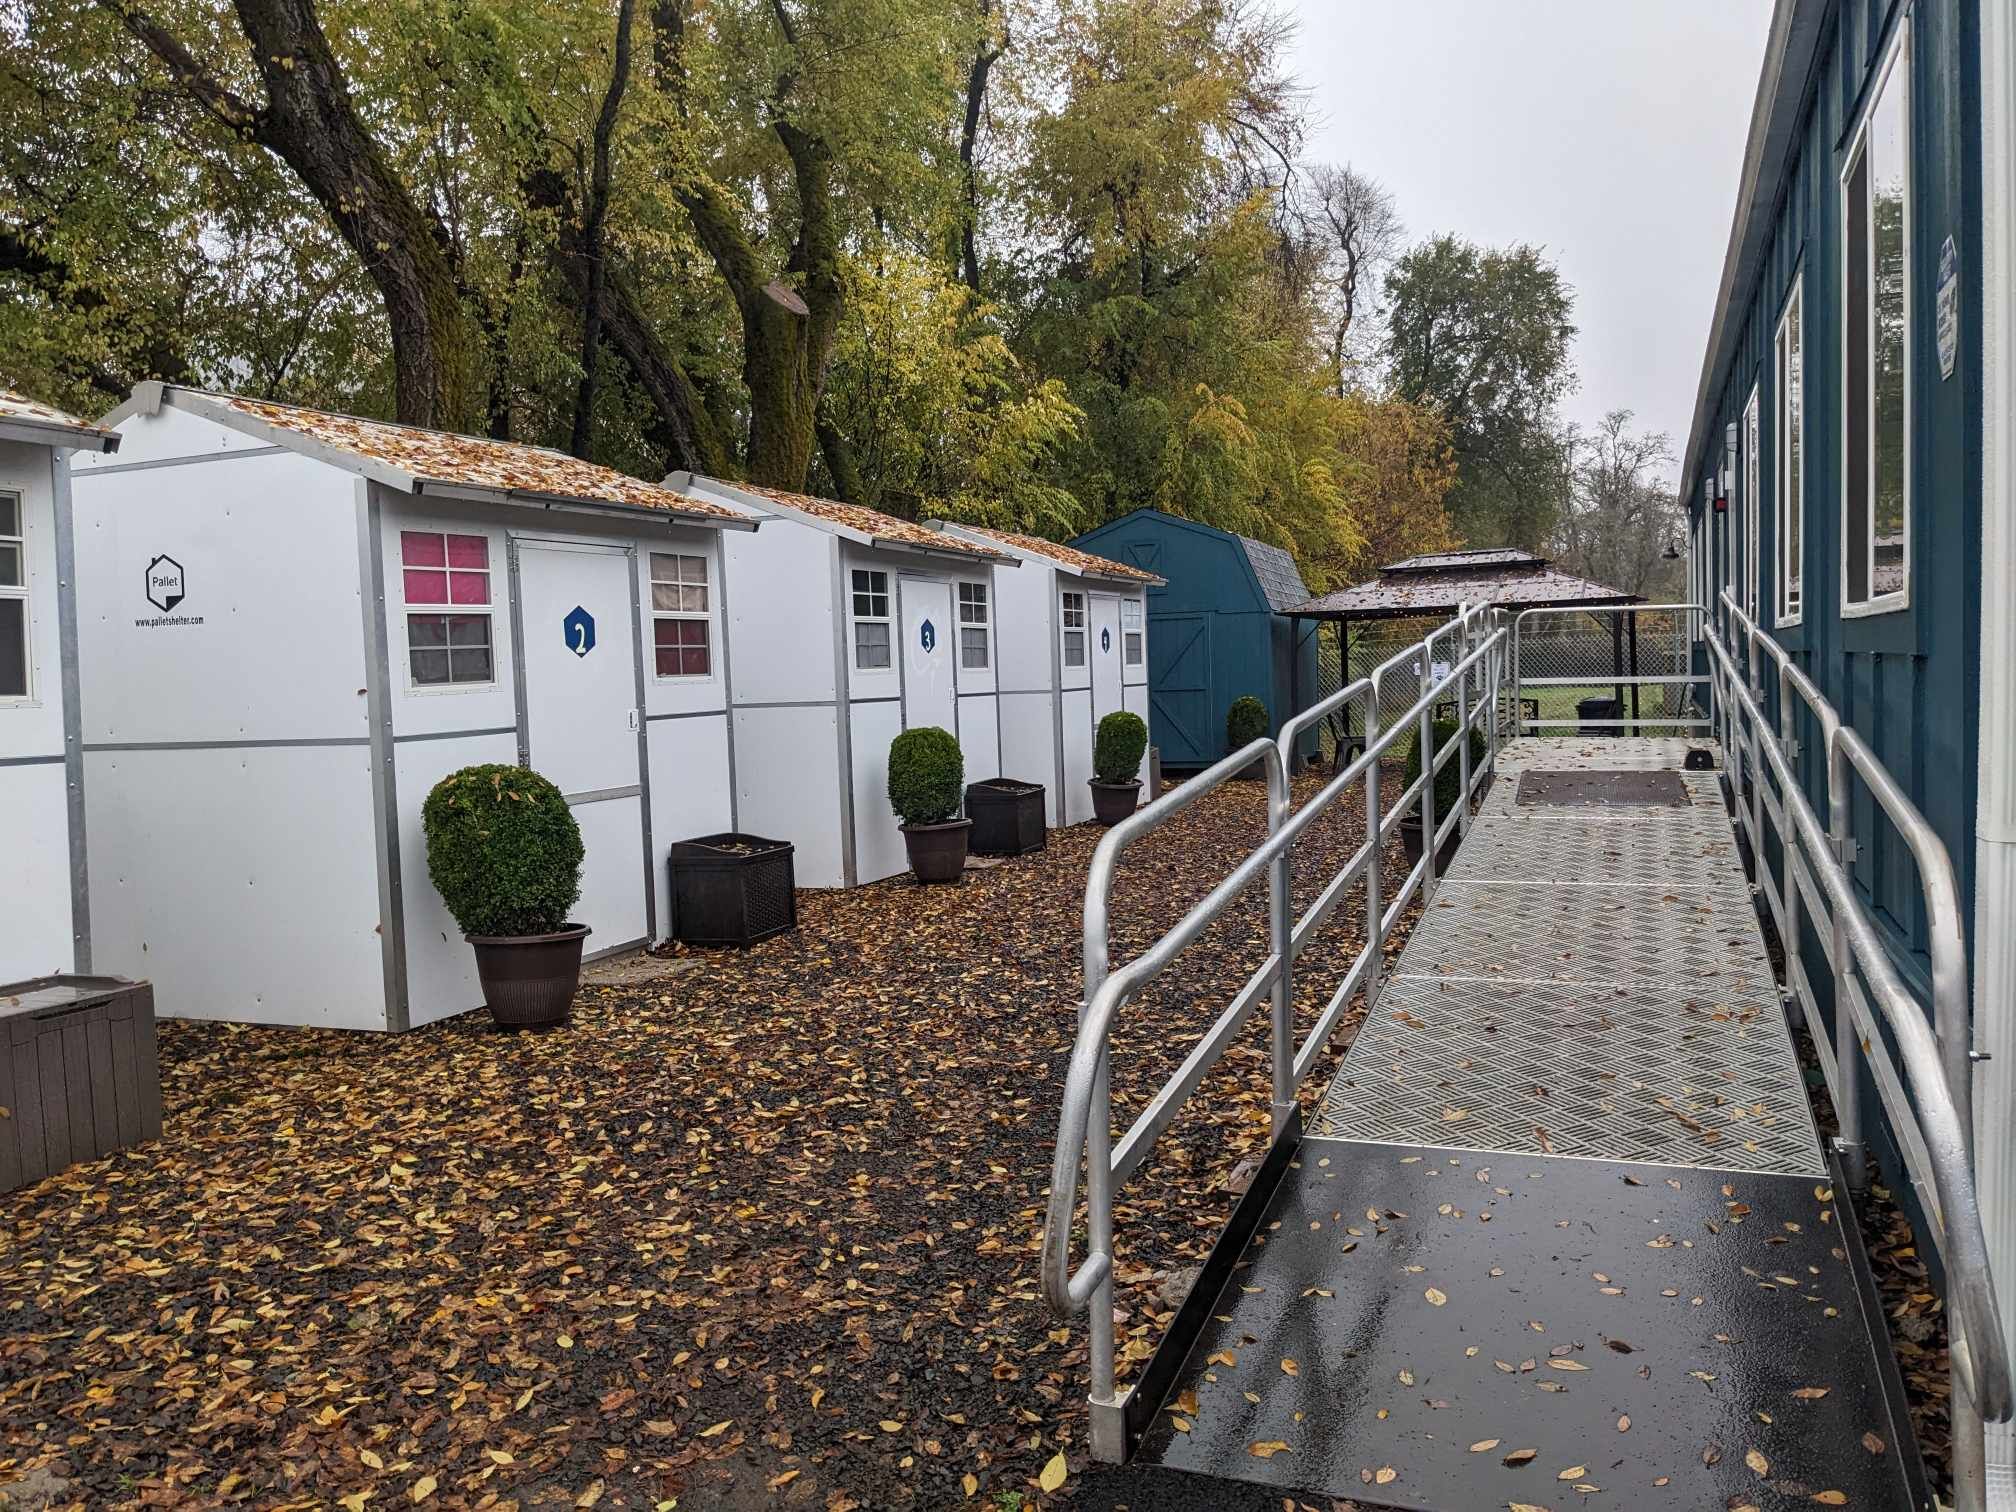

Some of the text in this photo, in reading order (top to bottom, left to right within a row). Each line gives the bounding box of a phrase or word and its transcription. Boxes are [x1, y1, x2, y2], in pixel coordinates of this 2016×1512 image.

[152, 576, 178, 587] Pallet
[135, 616, 204, 628] www.palletshelter.com
[575, 623, 587, 653] 2
[924, 631, 931, 652] 3
